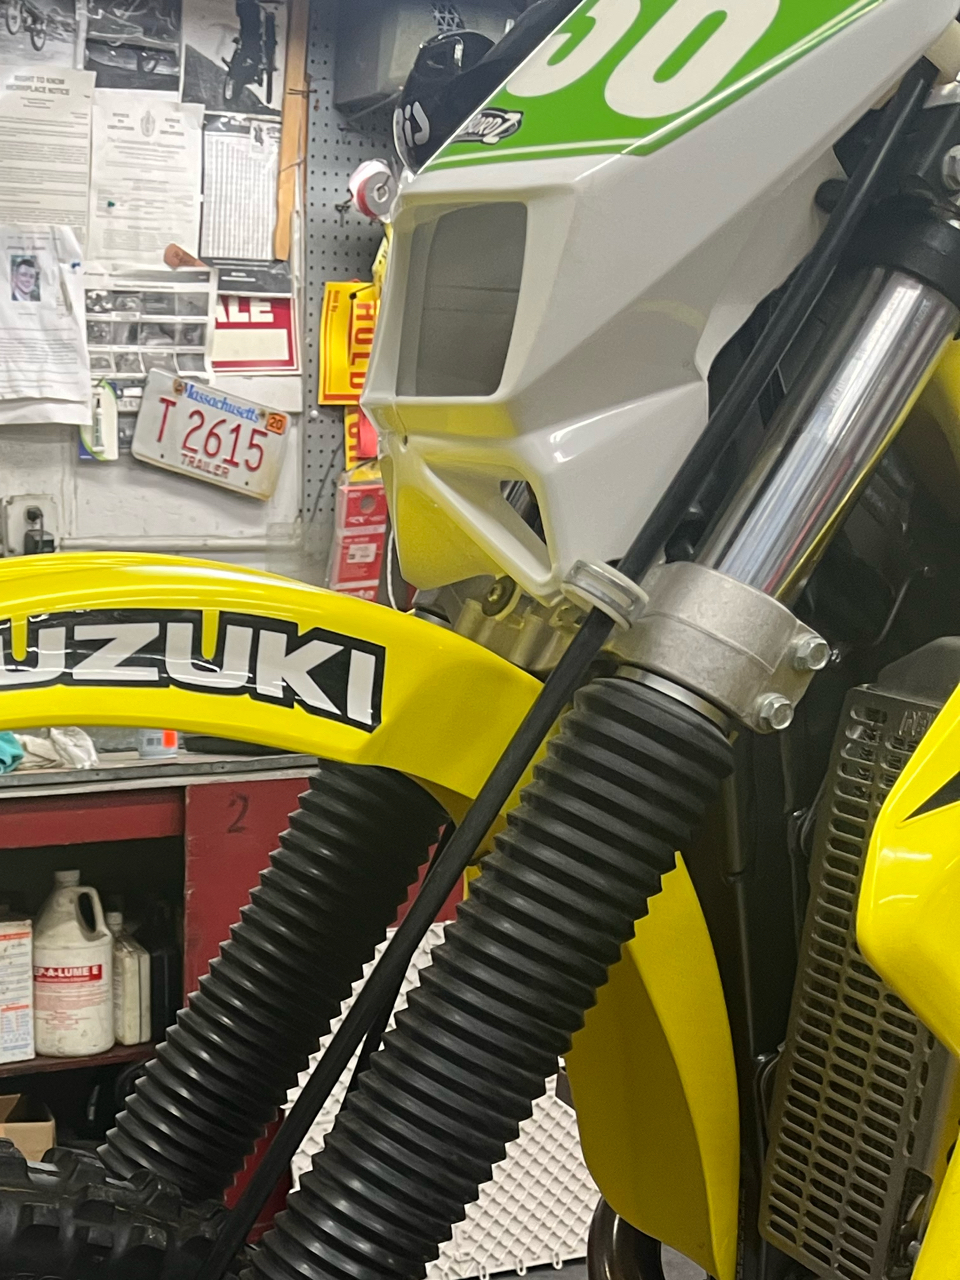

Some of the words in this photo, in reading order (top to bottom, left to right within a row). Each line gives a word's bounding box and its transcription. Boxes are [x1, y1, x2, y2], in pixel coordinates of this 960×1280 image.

[185, 384, 260, 424] Massachusetts
[156, 396, 178, 443] T
[182, 409, 269, 473] 2615
[269, 416, 284, 431] 20
[180, 452, 231, 479] TRAILER
[226, 791, 249, 834] 2
[92, 965, 100, 975] E
